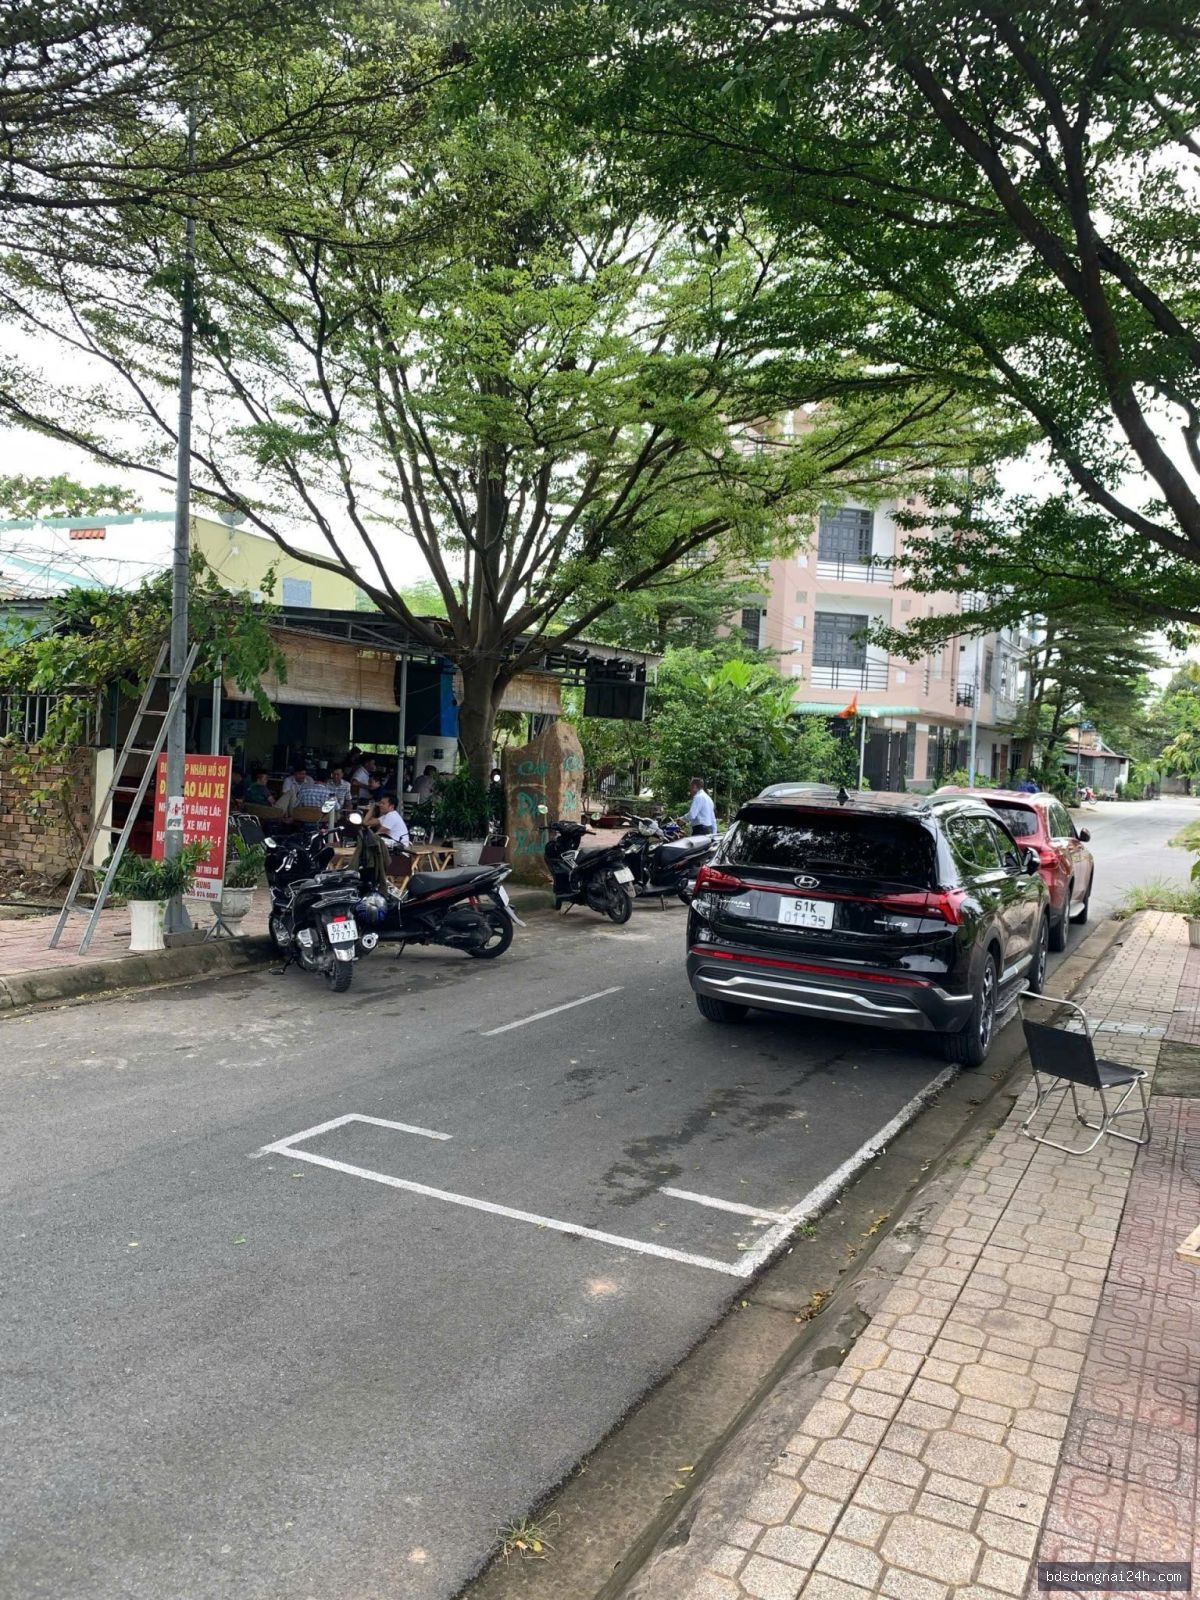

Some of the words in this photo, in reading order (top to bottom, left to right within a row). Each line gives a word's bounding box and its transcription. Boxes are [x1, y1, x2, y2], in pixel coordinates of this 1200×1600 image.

[214, 783, 225, 799] XE
[186, 820, 196, 830] XE
[795, 900, 816, 913] 61K
